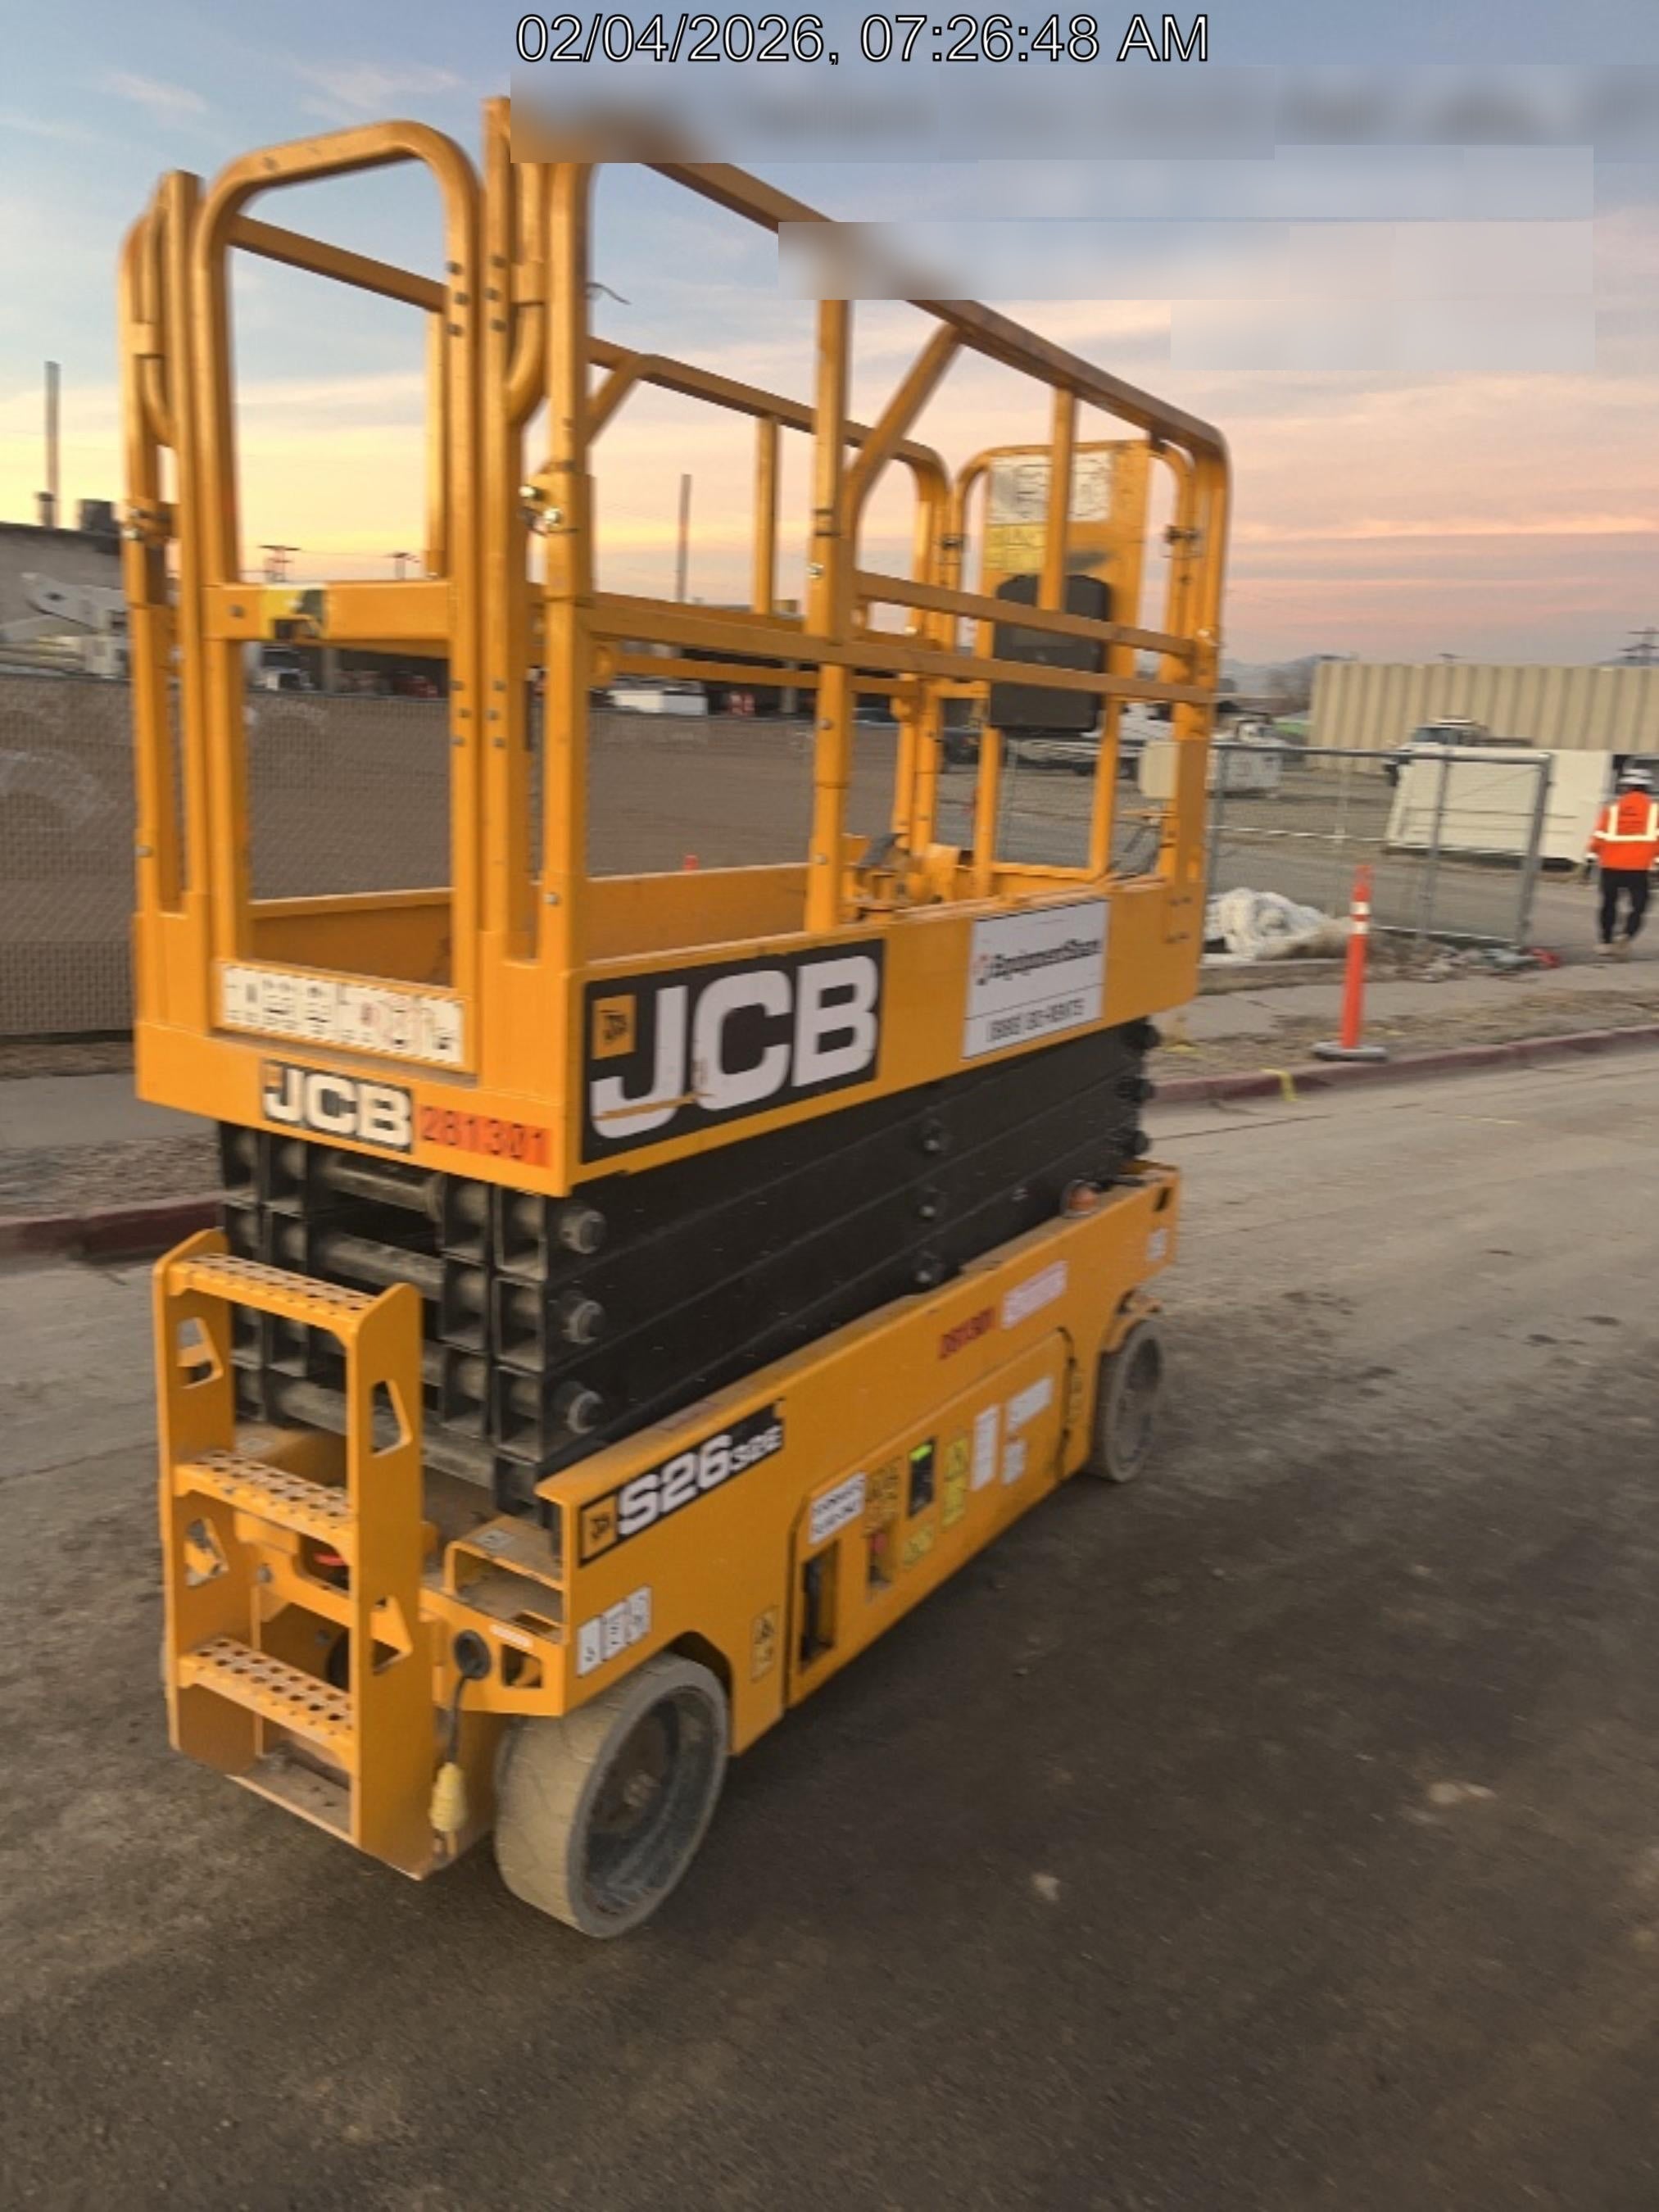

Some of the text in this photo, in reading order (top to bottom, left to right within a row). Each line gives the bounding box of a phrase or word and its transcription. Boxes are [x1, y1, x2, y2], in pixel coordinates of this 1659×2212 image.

[590, 954, 877, 1139] JCB
[263, 1068, 412, 1145] JCB
[421, 1106, 548, 1166] 281301
